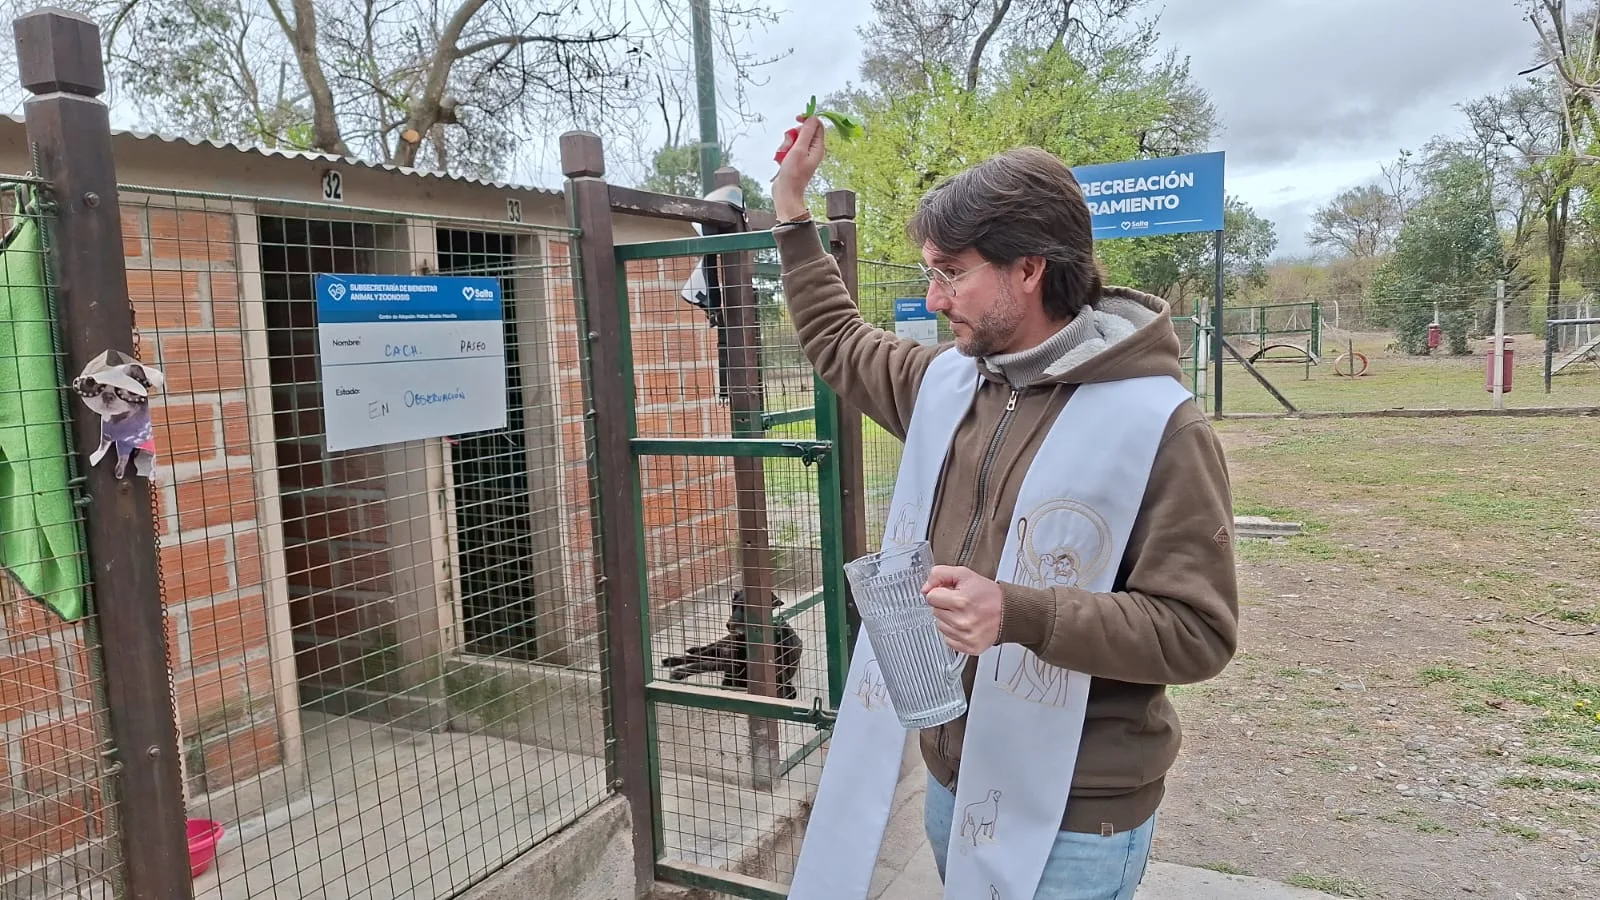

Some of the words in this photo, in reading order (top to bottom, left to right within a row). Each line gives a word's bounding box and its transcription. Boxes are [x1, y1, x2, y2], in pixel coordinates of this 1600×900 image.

[324, 173, 341, 199] 32
[1081, 170, 1194, 197] RECREACIÓN
[508, 200, 521, 222] 33
[399, 284, 408, 292] DE
[474, 288, 494, 298] Salta
[350, 293, 374, 301] ANIMAL
[460, 339, 487, 353] PASEO
[368, 400, 389, 420] EN
